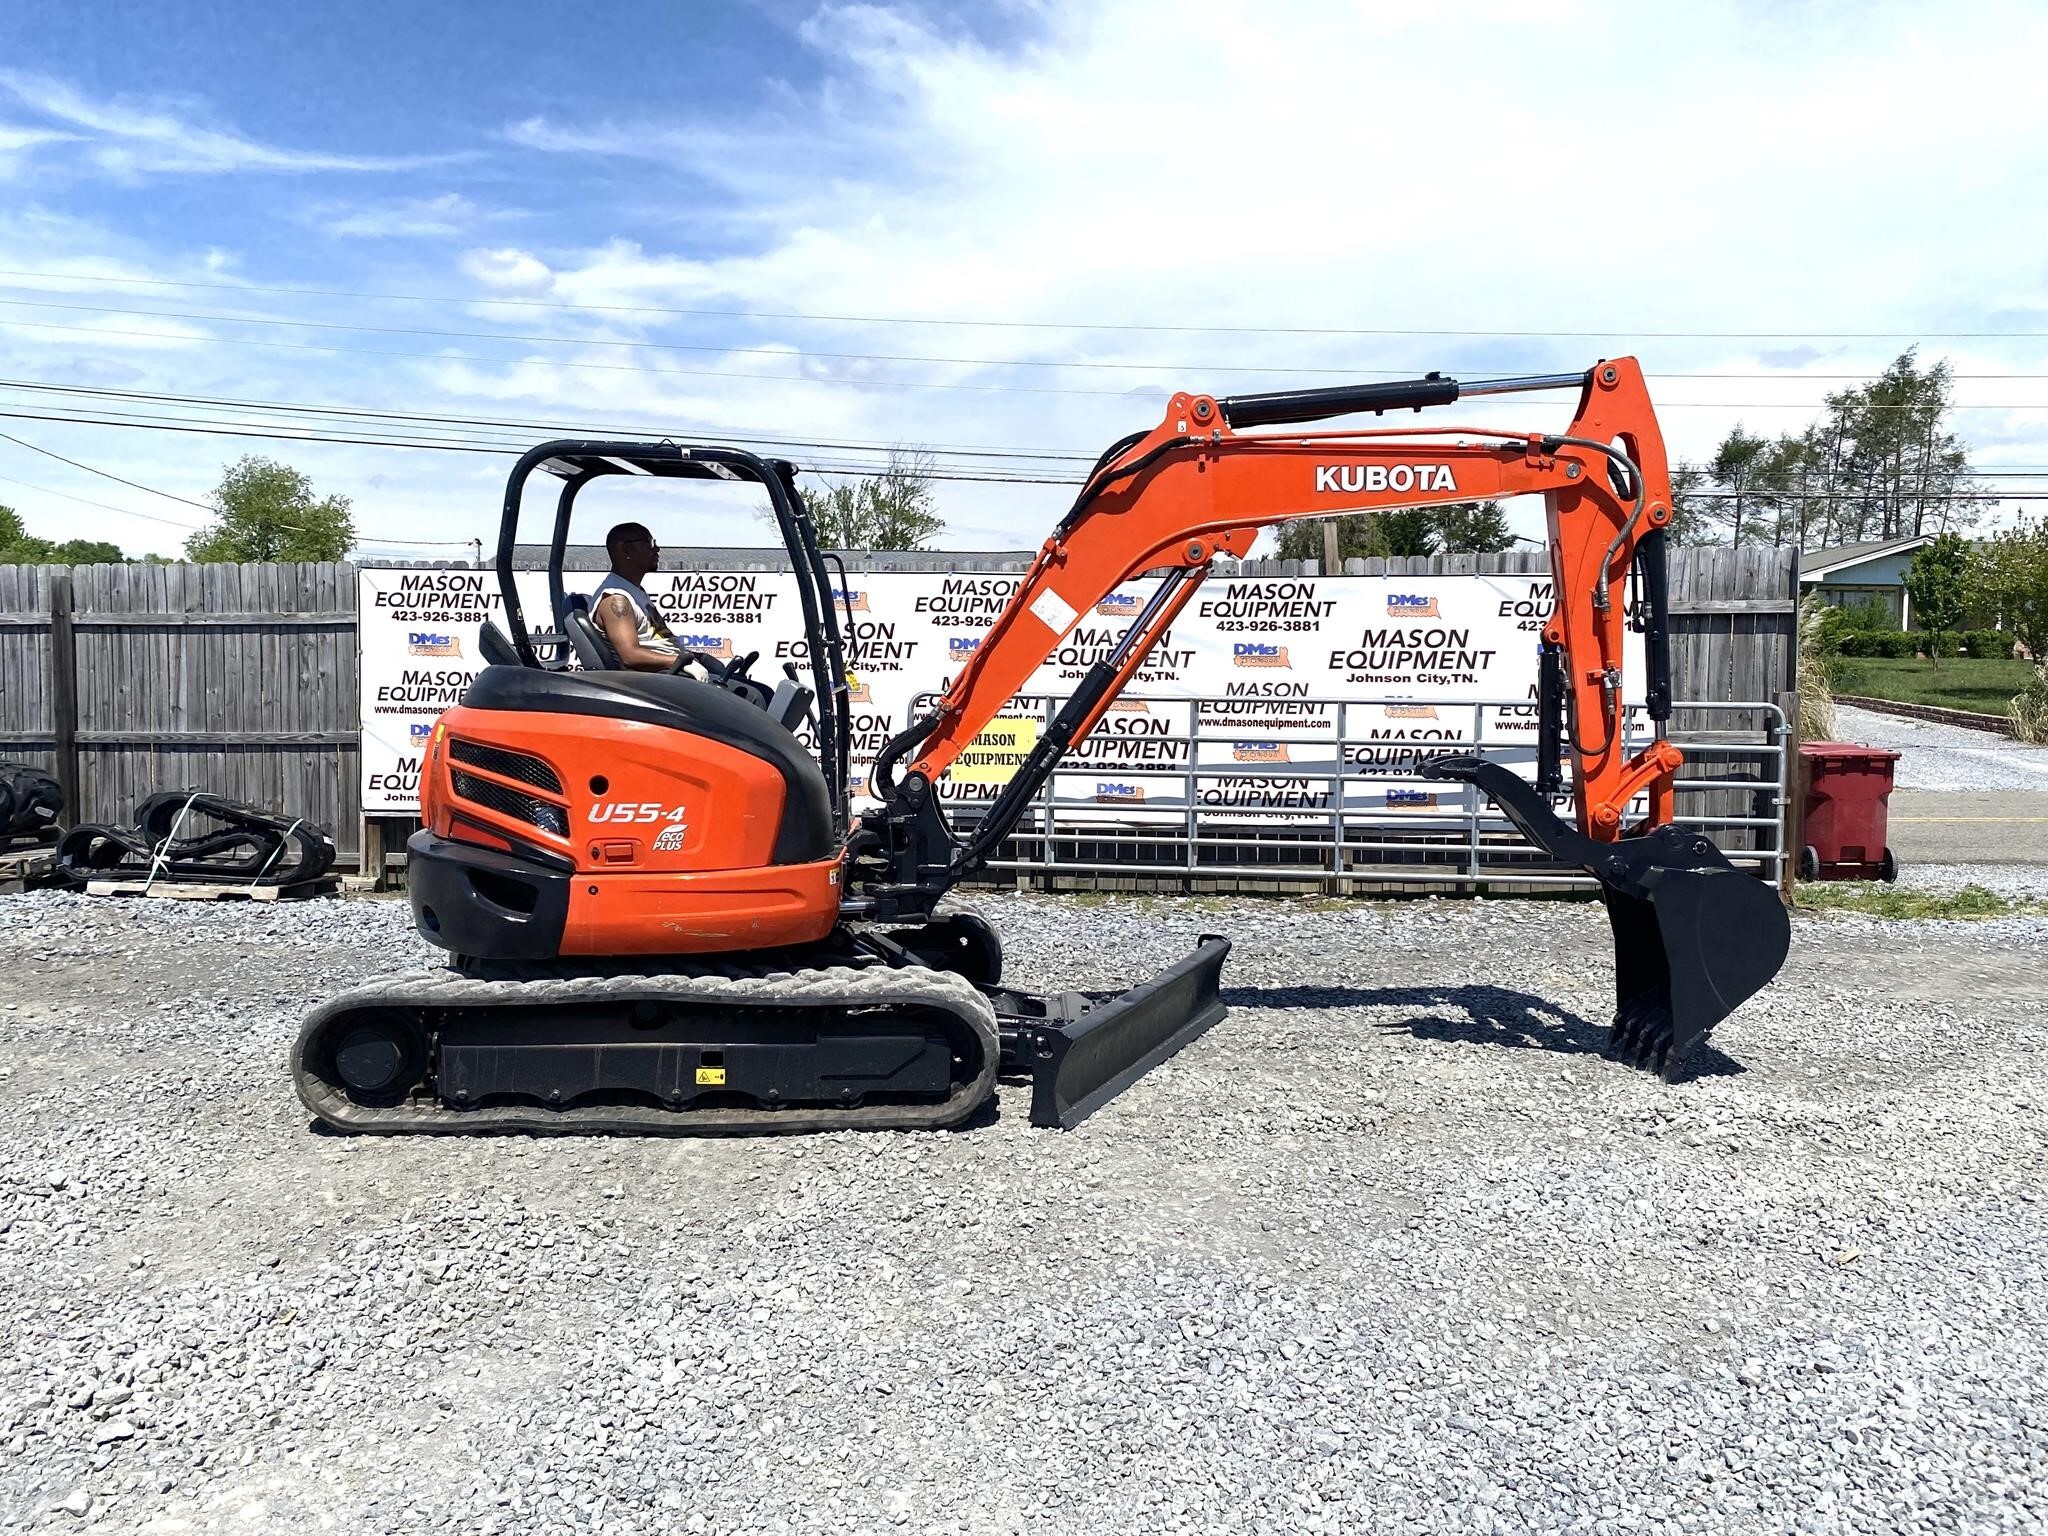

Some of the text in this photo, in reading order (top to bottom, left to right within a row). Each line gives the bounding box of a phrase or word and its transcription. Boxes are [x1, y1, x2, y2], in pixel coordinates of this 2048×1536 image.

[1316, 464, 1458, 492] KUBOTA
[400, 575, 483, 591] MASON
[672, 576, 756, 592] MASON
[1226, 583, 1315, 600] MASON
[375, 591, 503, 609] EQUIPMENT
[915, 597, 1011, 613] EQUIPM
[391, 610, 489, 623] 423-926-3881
[1199, 601, 1337, 618] EQUIPMENT
[662, 612, 762, 623] 423-926-3881
[932, 615, 997, 627] 423-926-
[1216, 620, 1320, 632] 423-926-3881
[1362, 628, 1469, 649] MASON
[1328, 650, 1497, 670] EQUIPMENT
[1134, 671, 1180, 682] ity,TN.
[1346, 673, 1478, 686] Johnson City,TN.
[1226, 682, 1310, 697] MASON
[1094, 718, 1171, 735] ASON
[1198, 717, 1331, 730] www.dmasonequipment.com
[971, 734, 1016, 746] MASON
[1344, 747, 1470, 766] EQUIPM
[1217, 778, 1309, 790] MASON
[384, 794, 421, 802] Johns
[1197, 789, 1334, 808] EQUIPMENT
[661, 832, 684, 842] eco
[652, 841, 683, 851] PLUS
